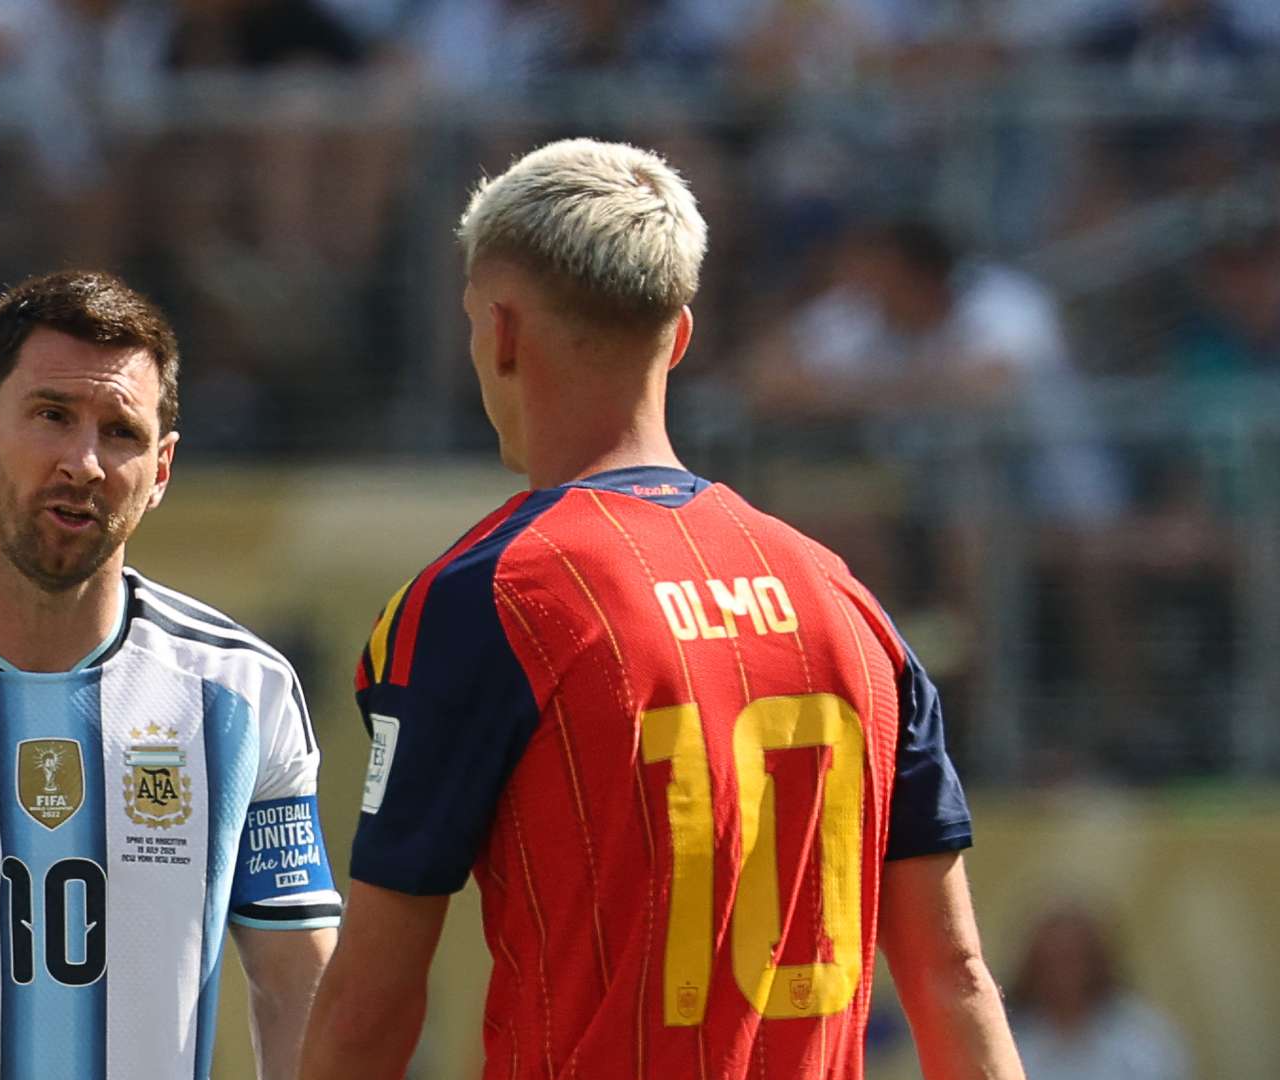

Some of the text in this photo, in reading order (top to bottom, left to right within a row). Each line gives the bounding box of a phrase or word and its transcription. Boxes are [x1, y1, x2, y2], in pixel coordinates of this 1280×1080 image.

[654, 575, 798, 641] OLMO
[36, 795, 66, 806] FIFA
[136, 767, 179, 806] AFA
[247, 803, 312, 828] FOOTBALL
[249, 820, 315, 851] UNITES
[246, 844, 320, 875] the World
[640, 692, 865, 1027] 10
[278, 873, 307, 886] FIFA
[1, 855, 108, 987] 10
